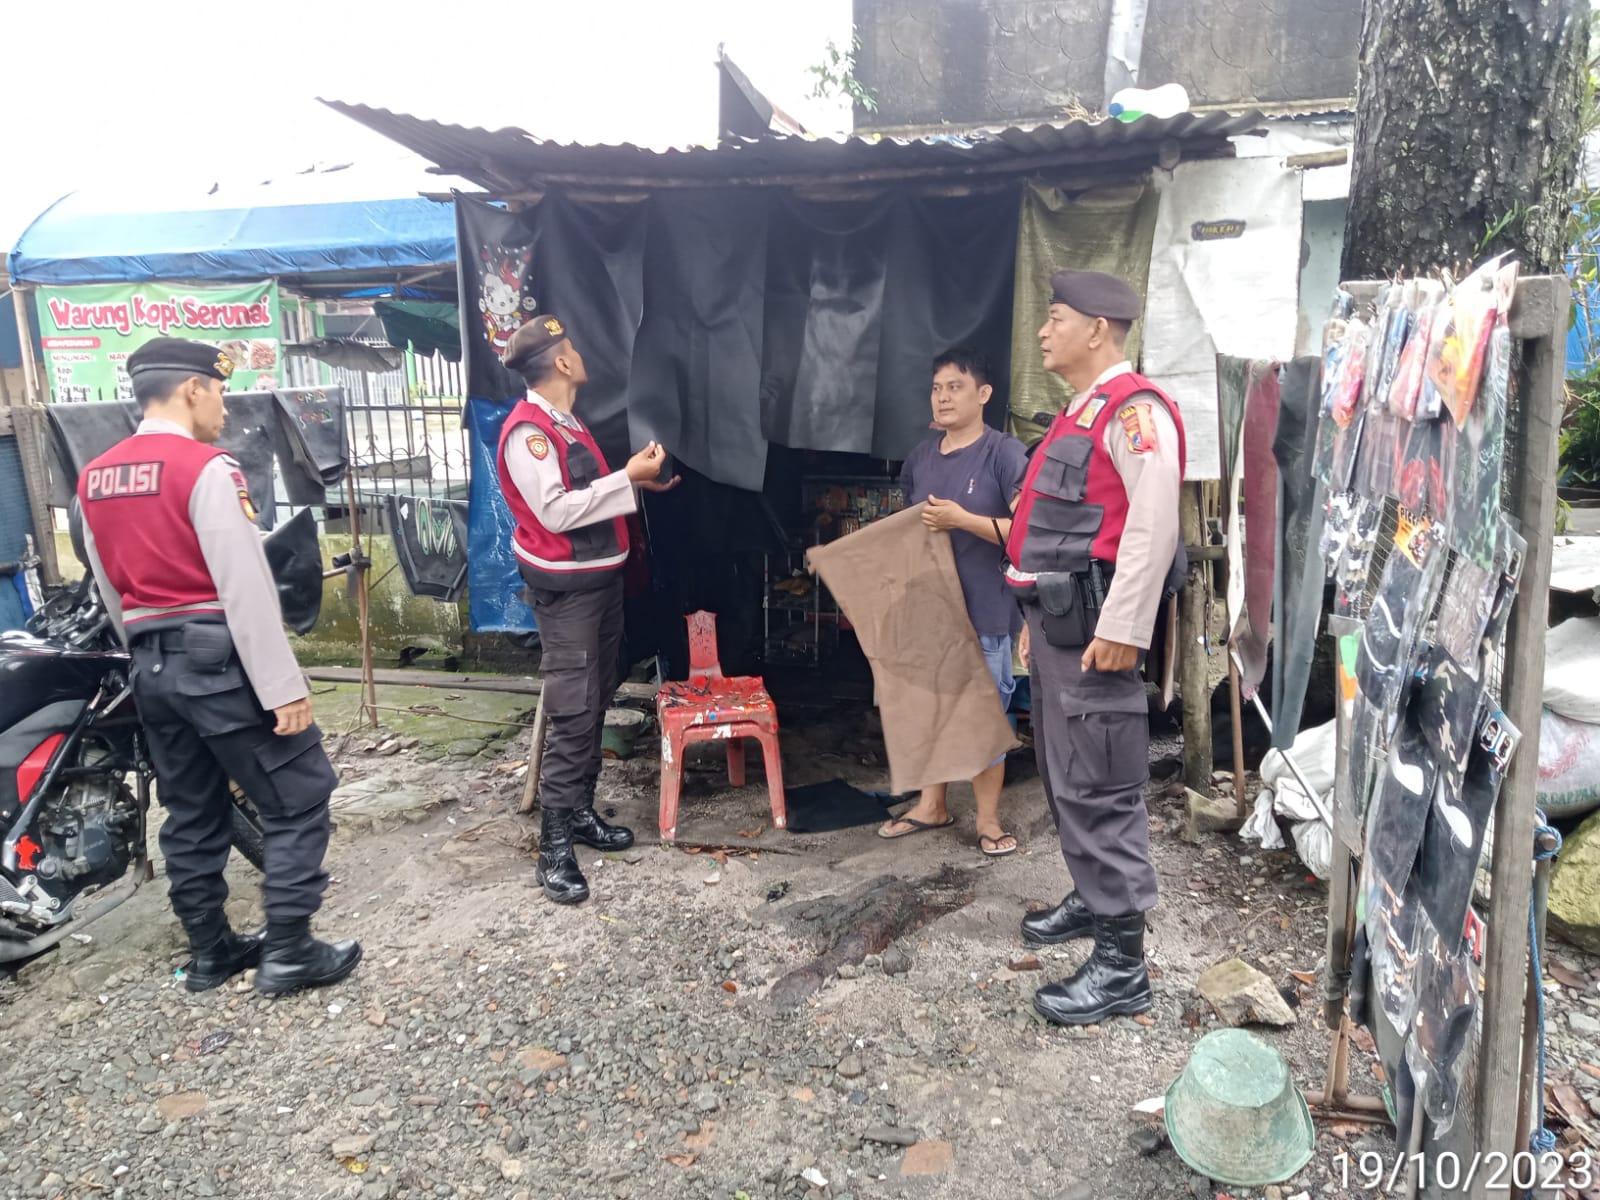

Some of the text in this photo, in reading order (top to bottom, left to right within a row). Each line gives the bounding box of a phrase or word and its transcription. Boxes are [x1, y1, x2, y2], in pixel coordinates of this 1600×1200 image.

[49, 295, 271, 334] Warung Kopi Serunai
[87, 463, 160, 498] POLISI
